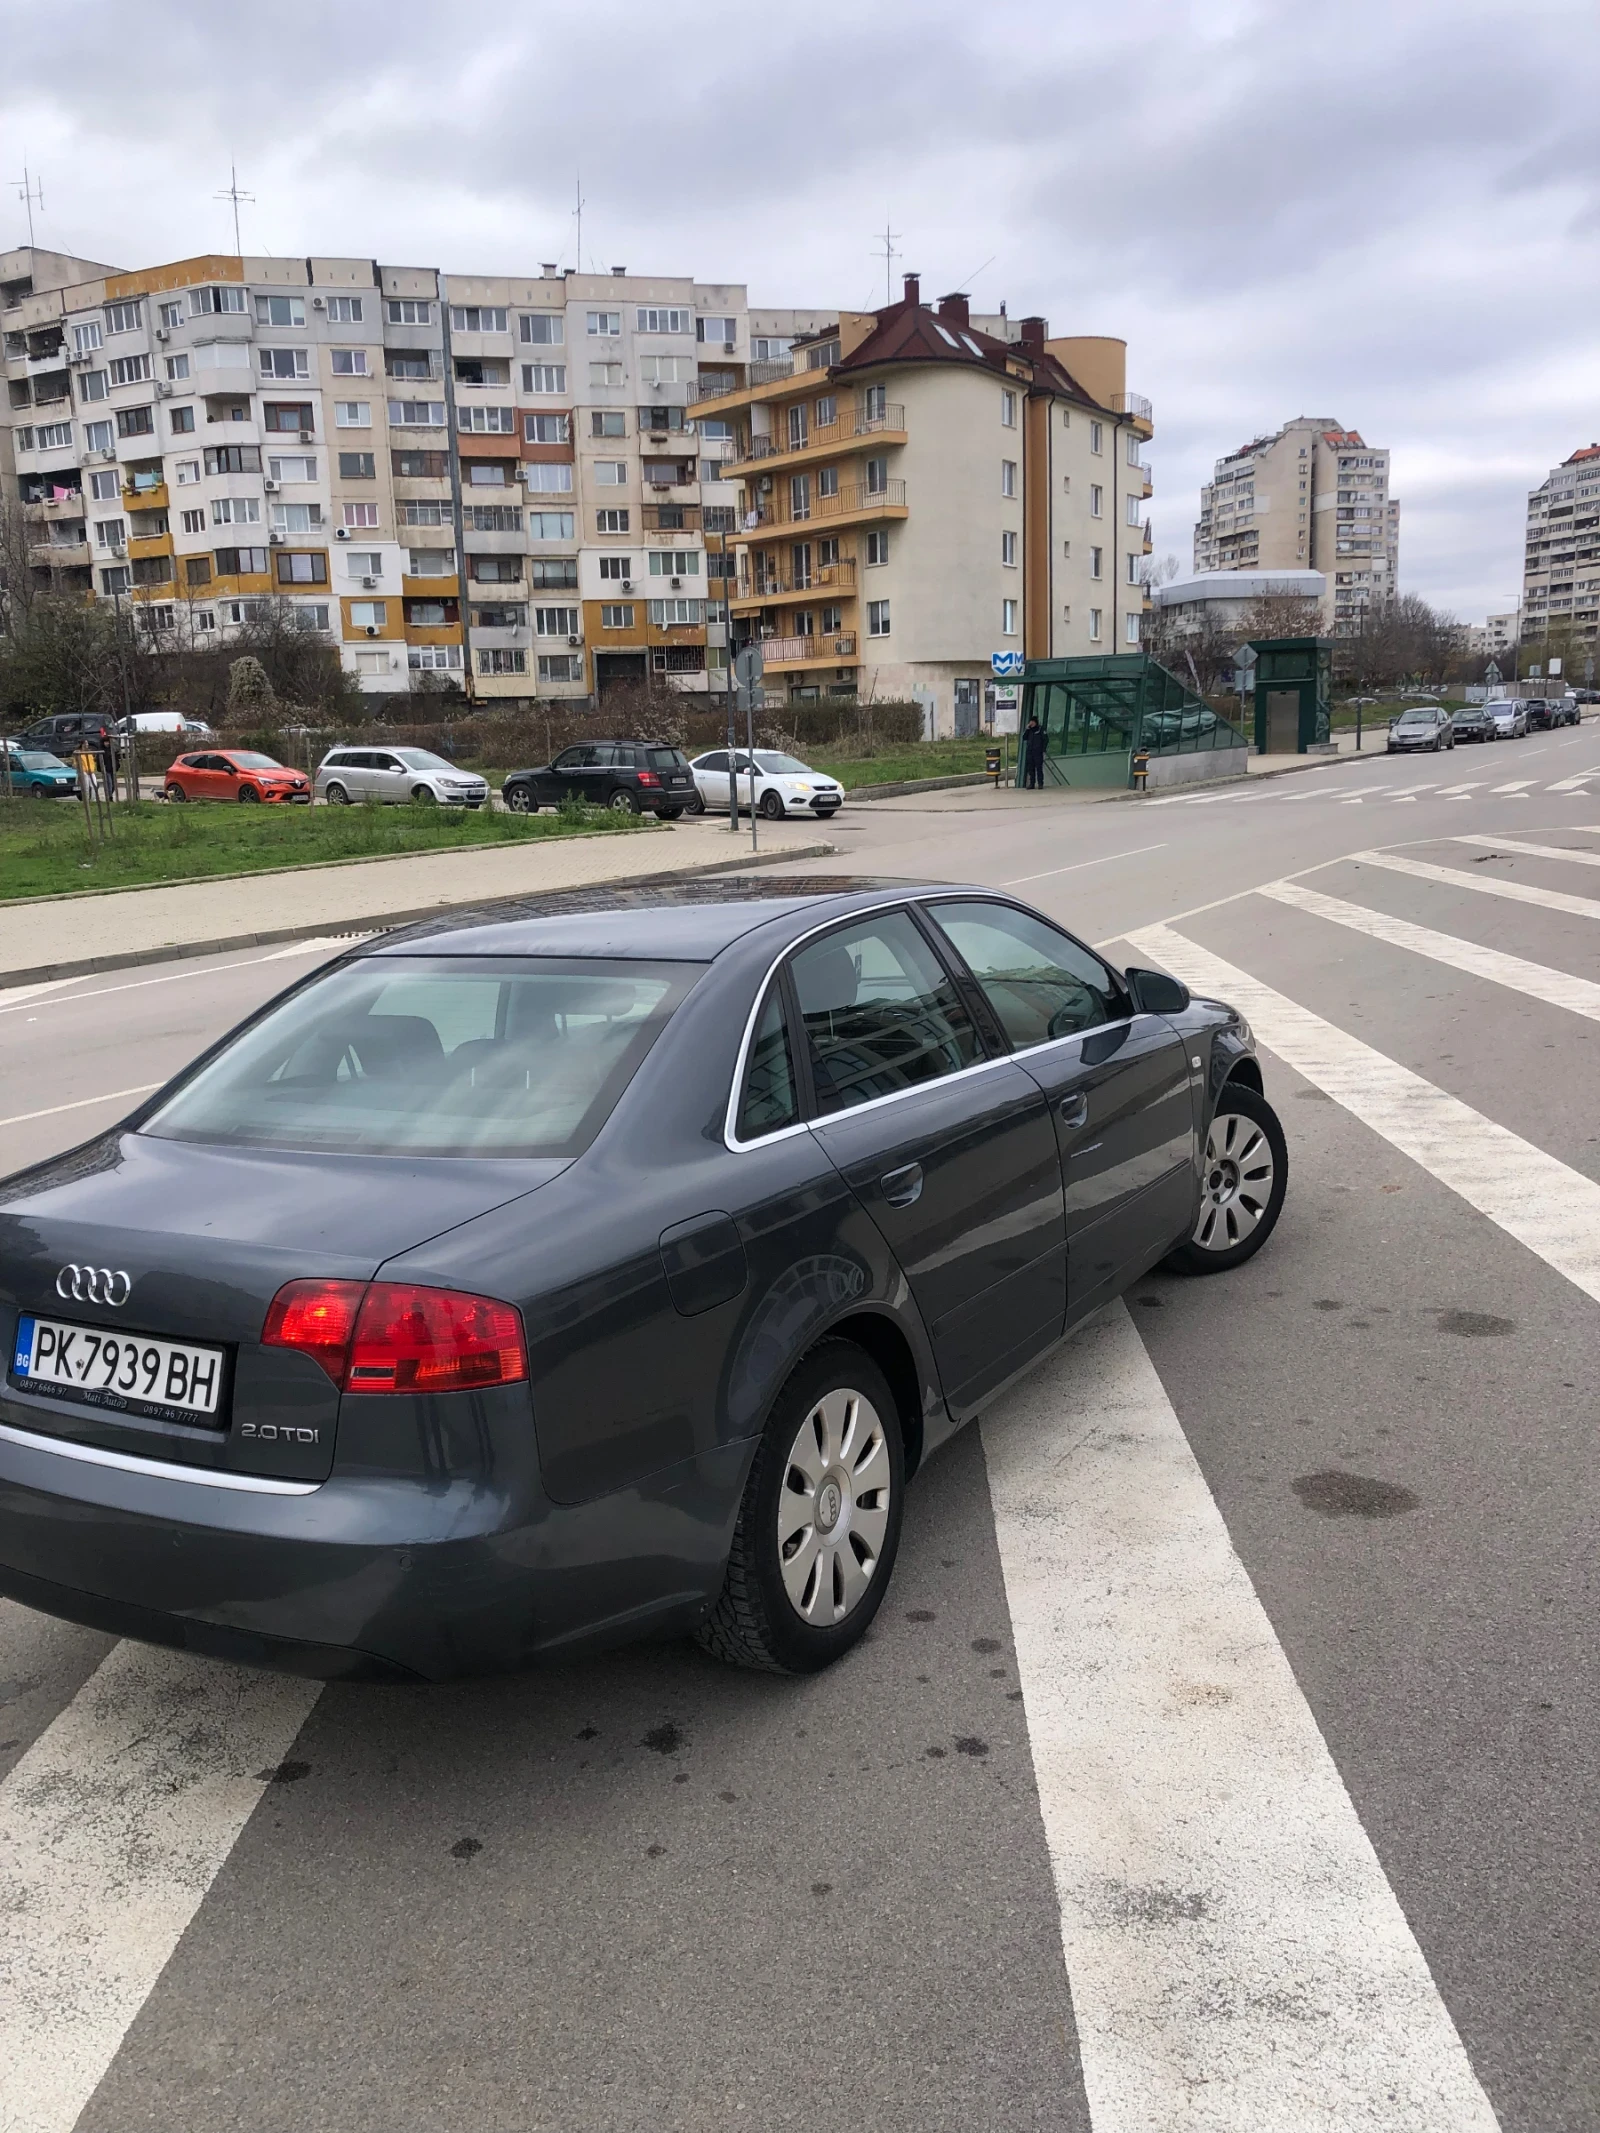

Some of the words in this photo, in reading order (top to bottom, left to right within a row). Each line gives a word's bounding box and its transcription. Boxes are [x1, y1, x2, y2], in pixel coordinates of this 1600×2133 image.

[16, 1353, 29, 1367] BG
[80, 1335, 161, 1395] 7939
[81, 1391, 101, 1404] Mati
[102, 1396, 122, 1408] Auto
[143, 1404, 164, 1416] 0897
[165, 1408, 175, 1418] 46
